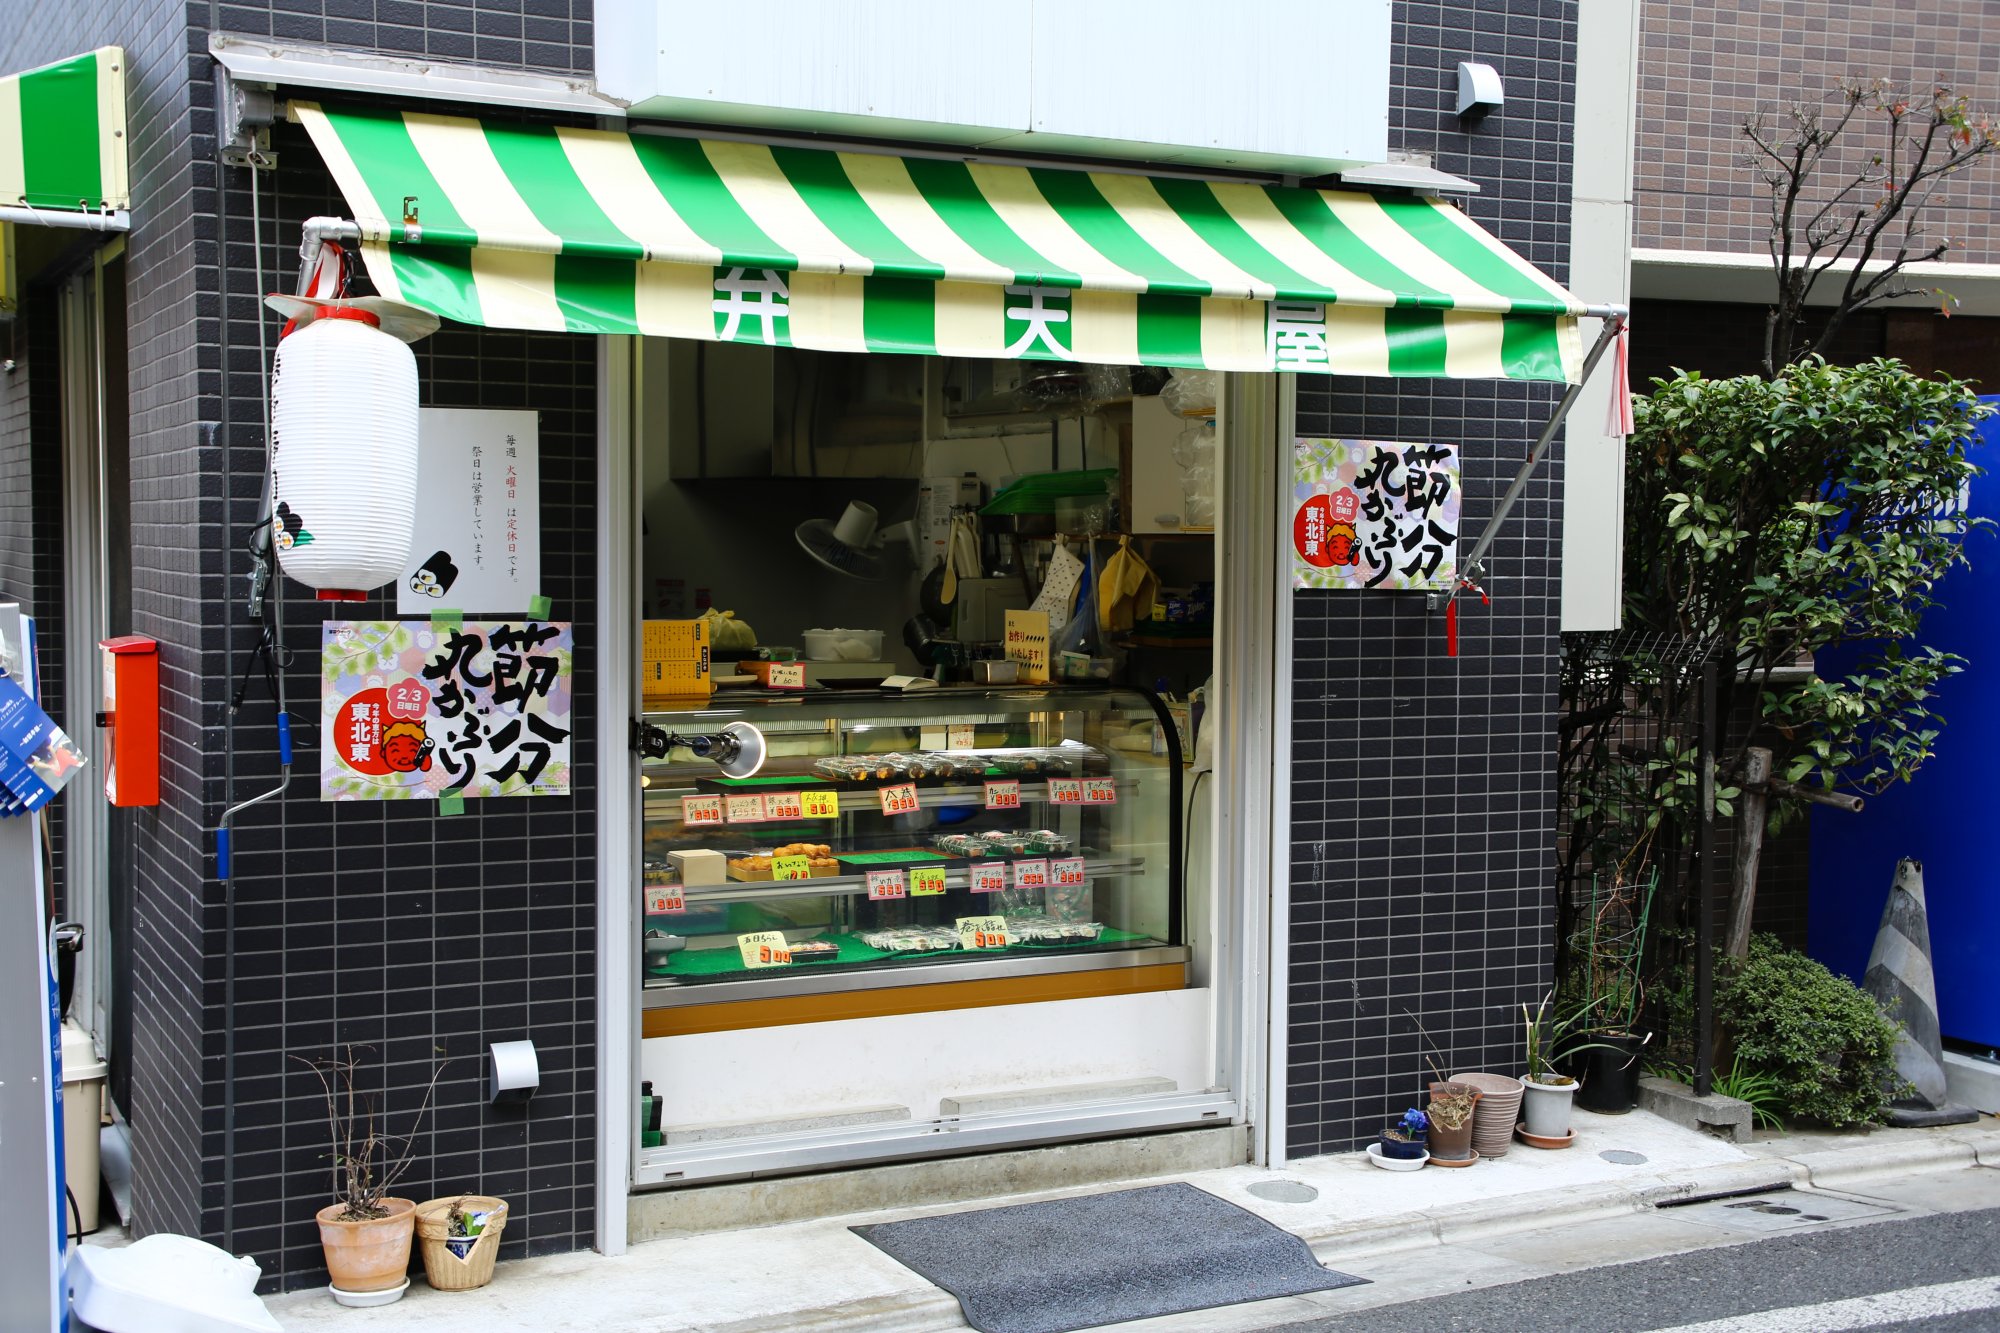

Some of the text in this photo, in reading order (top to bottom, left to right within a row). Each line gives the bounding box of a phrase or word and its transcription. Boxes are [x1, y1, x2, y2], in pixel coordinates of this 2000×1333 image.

[471, 446, 484, 571] 祭日は営業しています。
[505, 465, 518, 499] 火曜日
[1336, 495, 1354, 507] 2/3
[1305, 506, 1319, 556] 東北東
[1336, 506, 1352, 515] 日曜日
[1354, 446, 1406, 587] 丸かぶり
[1399, 445, 1457, 579] 節分
[396, 687, 422, 703] 2/3
[396, 702, 420, 712] 日曜日
[422, 628, 493, 798] 丸かぶり
[485, 623, 570, 784] 節分
[350, 702, 371, 762] 東北東
